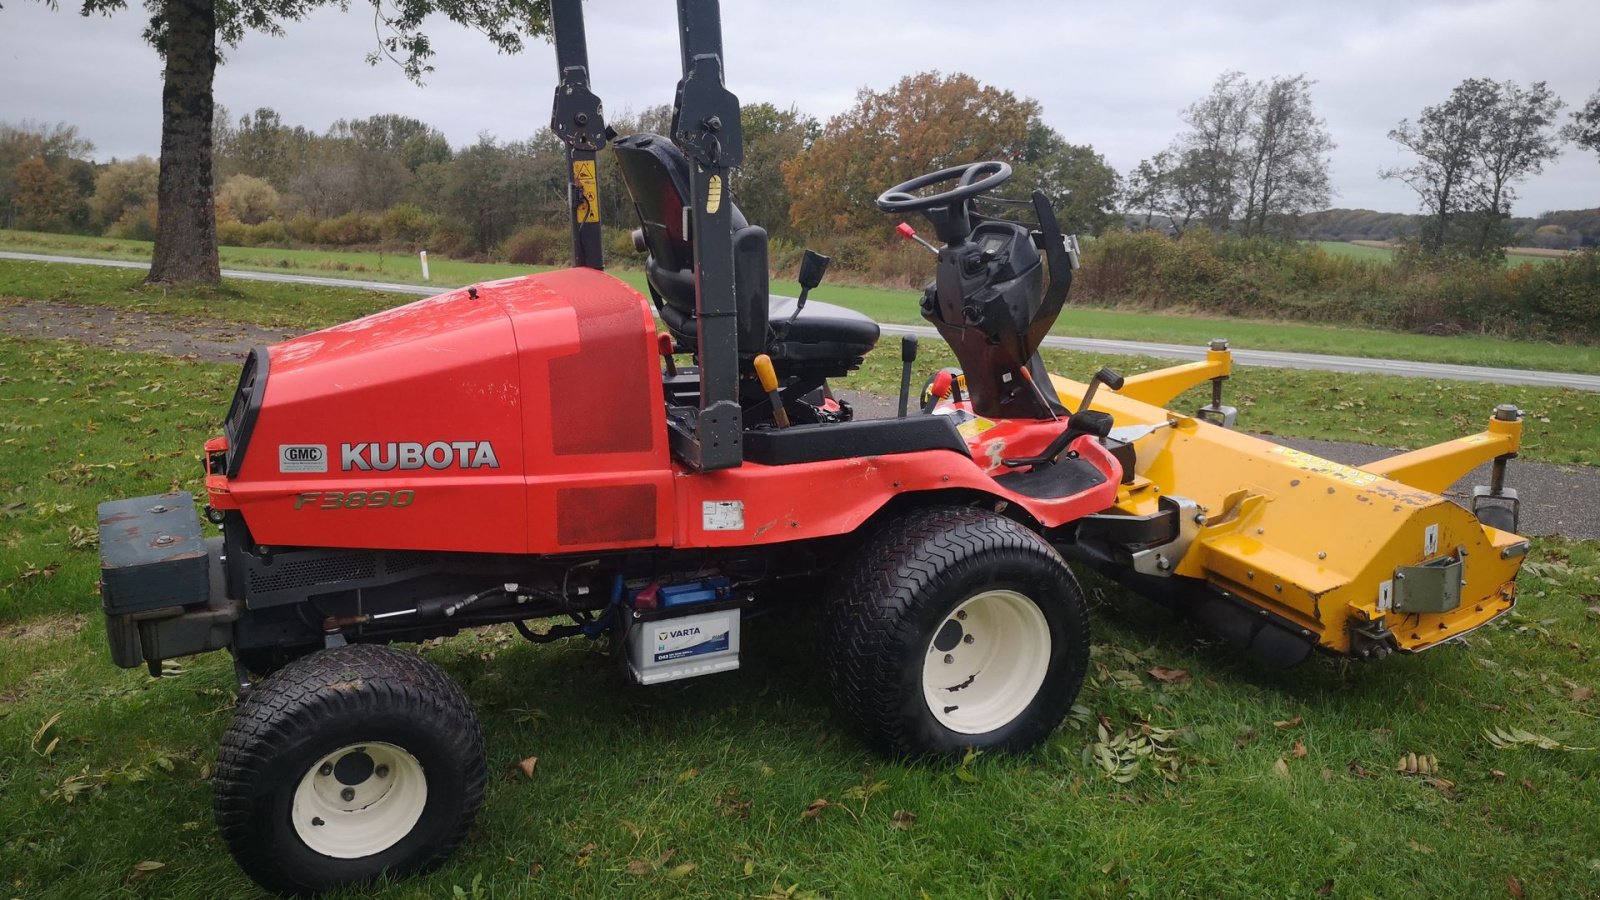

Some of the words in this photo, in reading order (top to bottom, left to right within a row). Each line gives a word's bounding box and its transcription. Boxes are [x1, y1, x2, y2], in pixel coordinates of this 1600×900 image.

[290, 449, 317, 460] GMC
[341, 441, 500, 471] KUBOTA
[294, 489, 416, 511] F3890
[670, 627, 700, 638] VARTA
